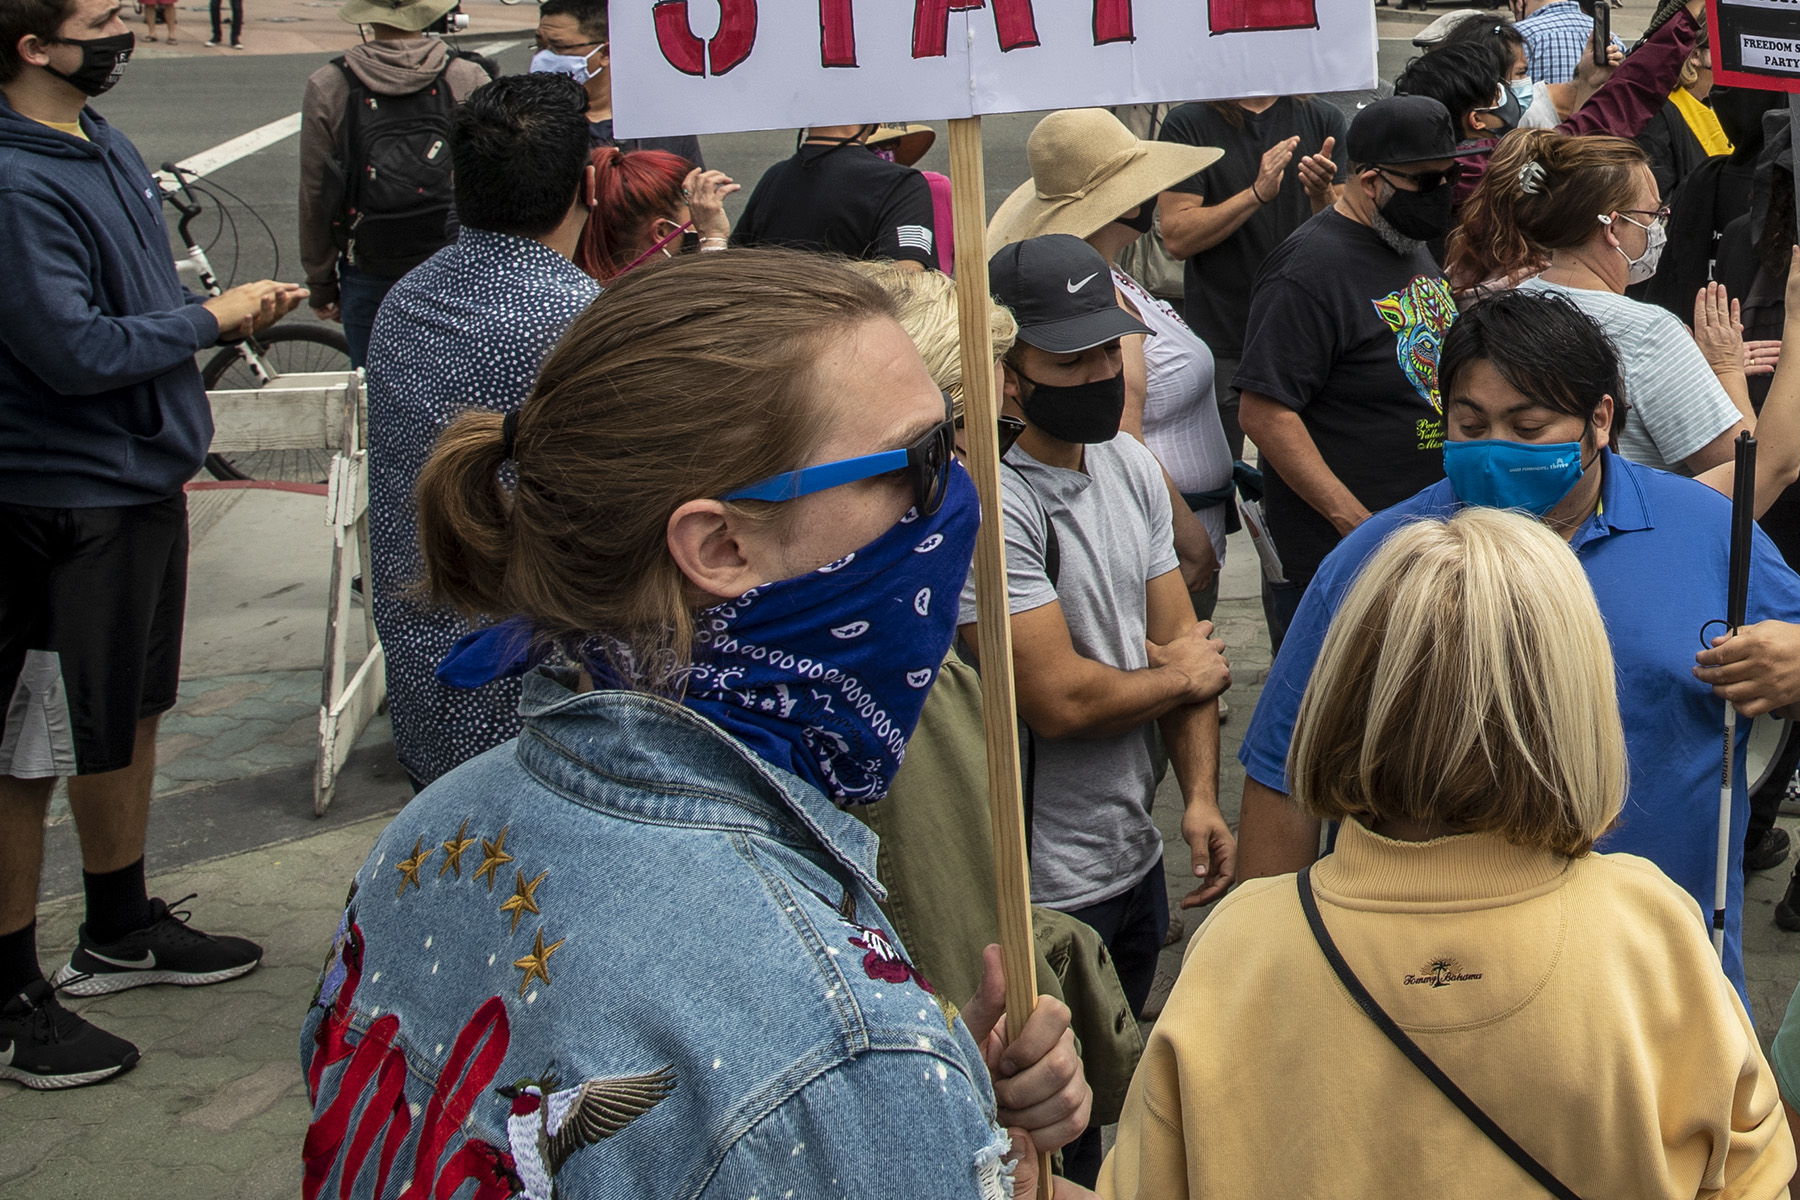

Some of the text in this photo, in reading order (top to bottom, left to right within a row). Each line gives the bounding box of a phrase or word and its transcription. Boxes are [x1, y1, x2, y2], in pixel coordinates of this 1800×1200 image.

[1743, 38, 1792, 53] FREEDOM
[1764, 55, 1800, 68] PARTY
[1416, 418, 1442, 430] Puert
[1416, 429, 1445, 440] Vallar
[1403, 971, 1483, 987] Tommy Bahama
